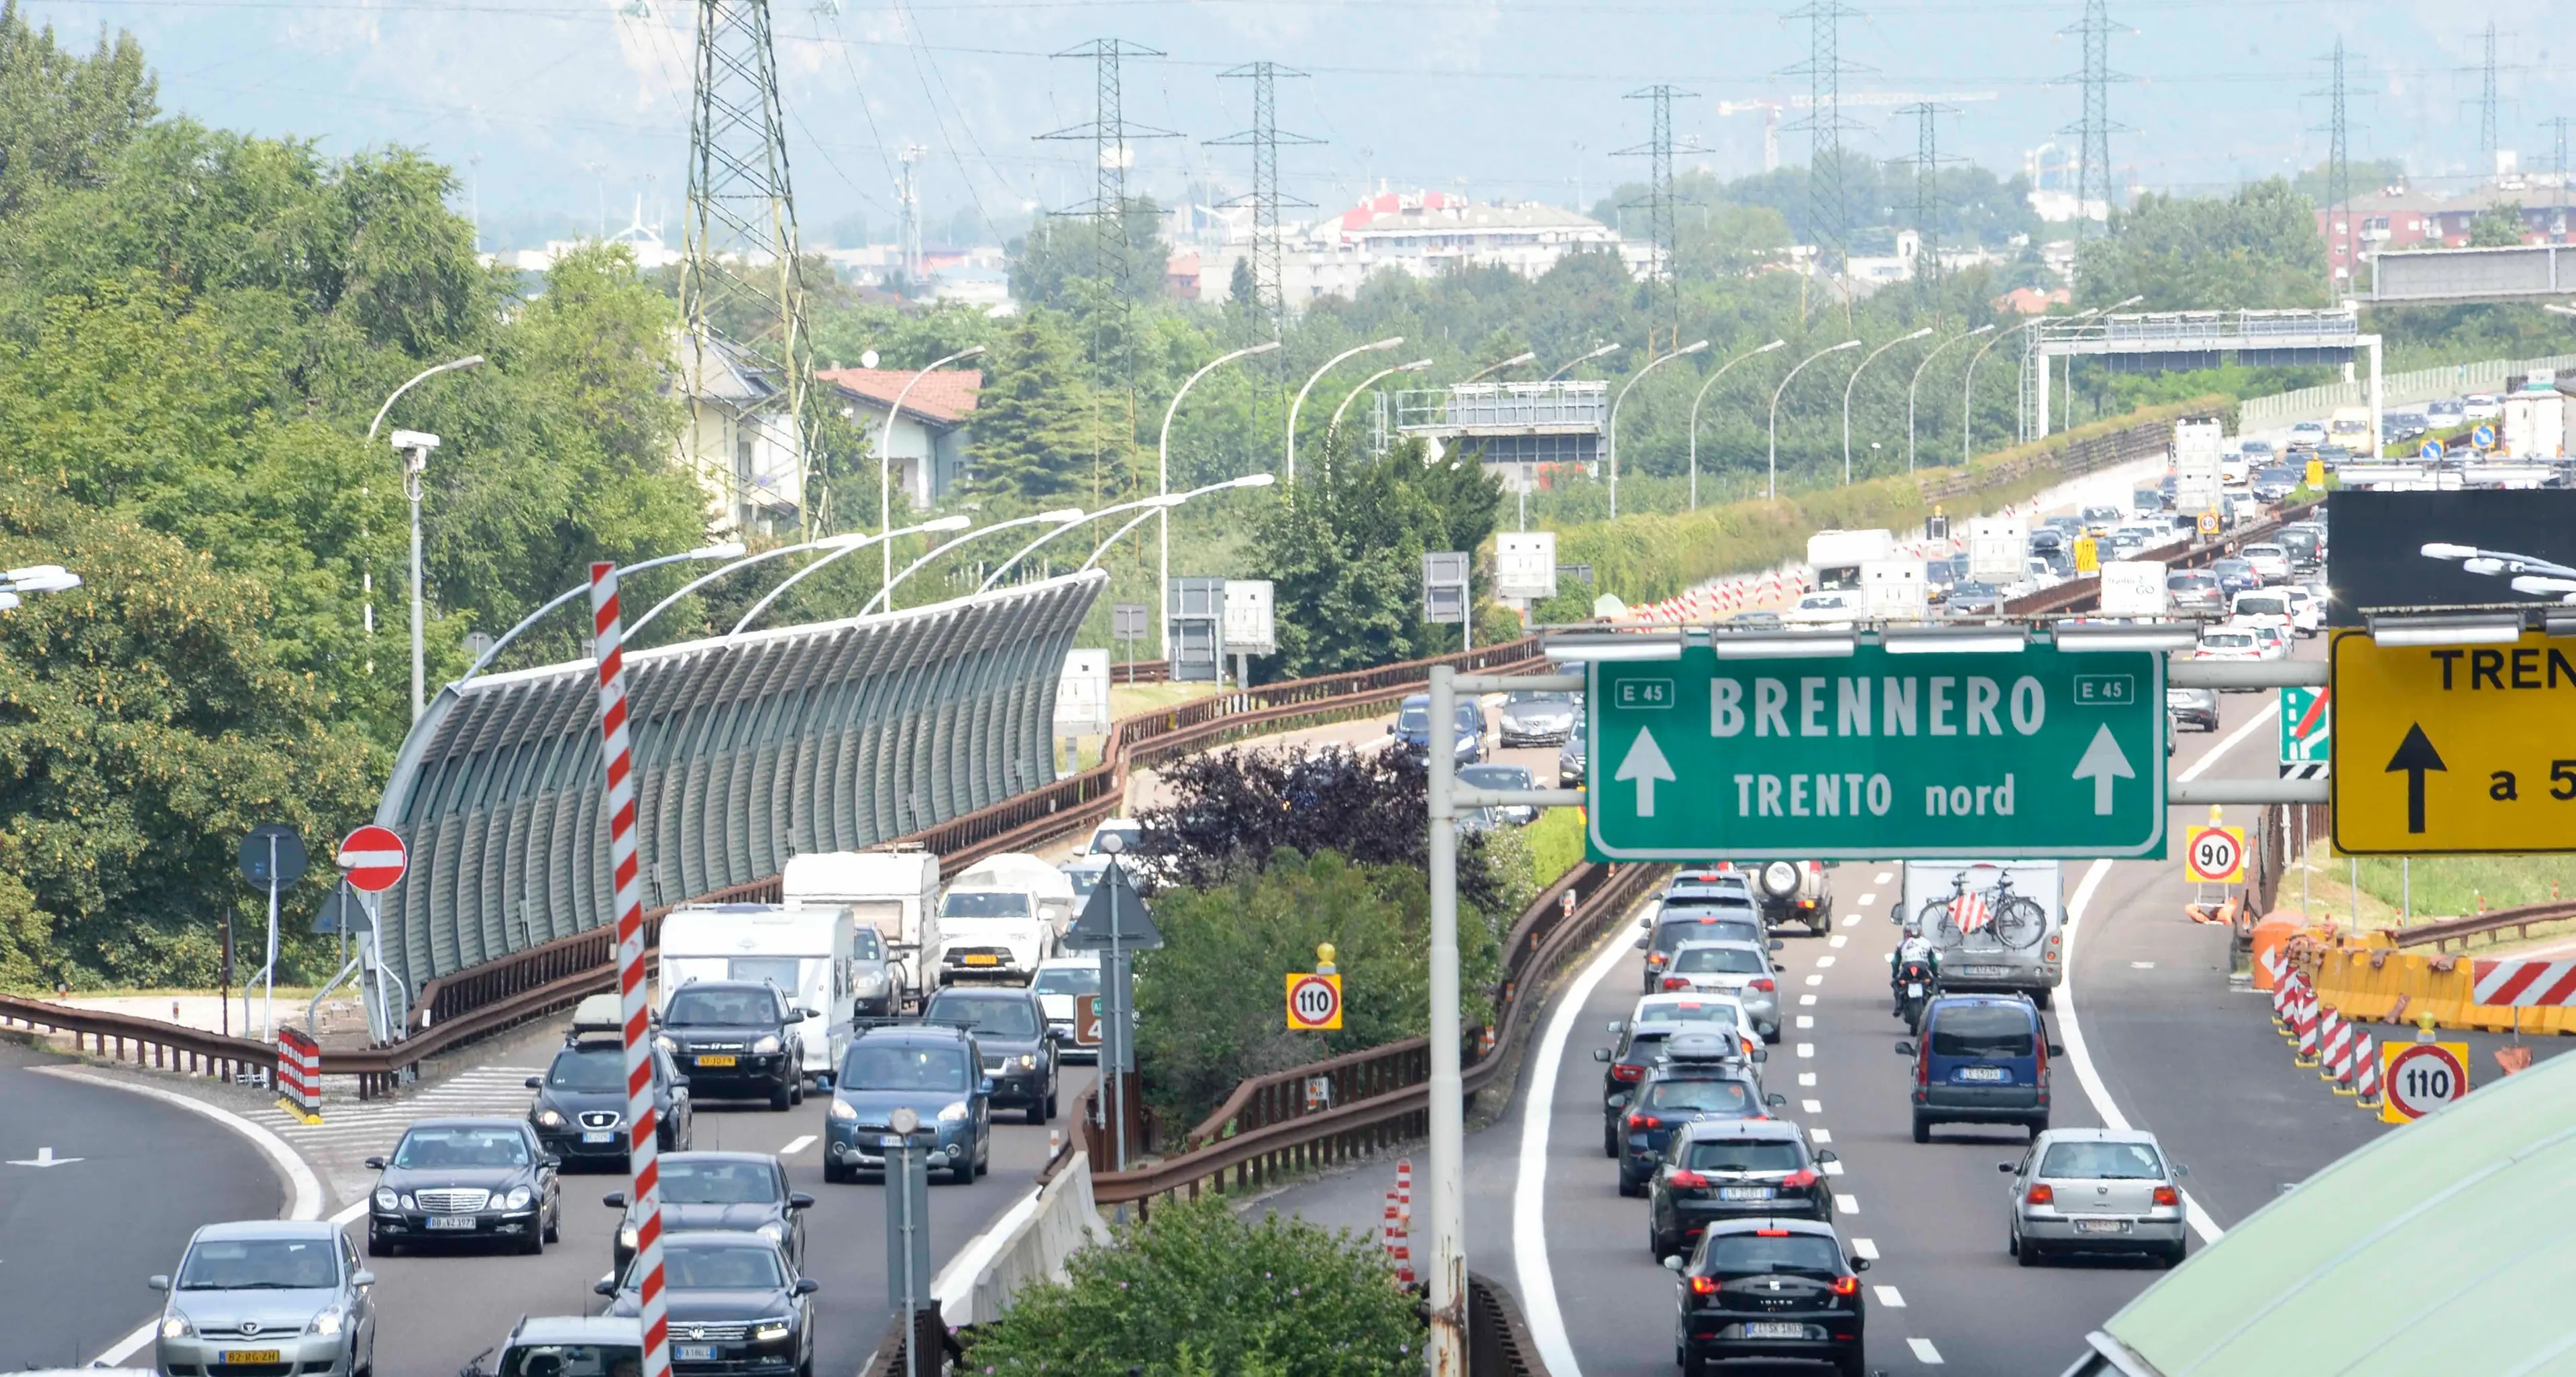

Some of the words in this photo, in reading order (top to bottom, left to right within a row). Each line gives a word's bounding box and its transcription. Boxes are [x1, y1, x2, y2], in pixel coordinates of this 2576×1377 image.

[2430, 649, 2576, 690] TREN
[1623, 685, 1635, 701] E
[1644, 685, 1662, 701] 45
[2082, 682, 2093, 698] E
[2102, 681, 2122, 698] 45
[1711, 675, 2045, 737] BRENNERO
[1733, 773, 1892, 816] TRENTO
[1925, 773, 2015, 816] nord
[2489, 770, 2518, 801] a
[2201, 844, 2229, 867] 90
[1300, 991, 1329, 1012] 110
[2407, 1068, 2449, 1099] 110
